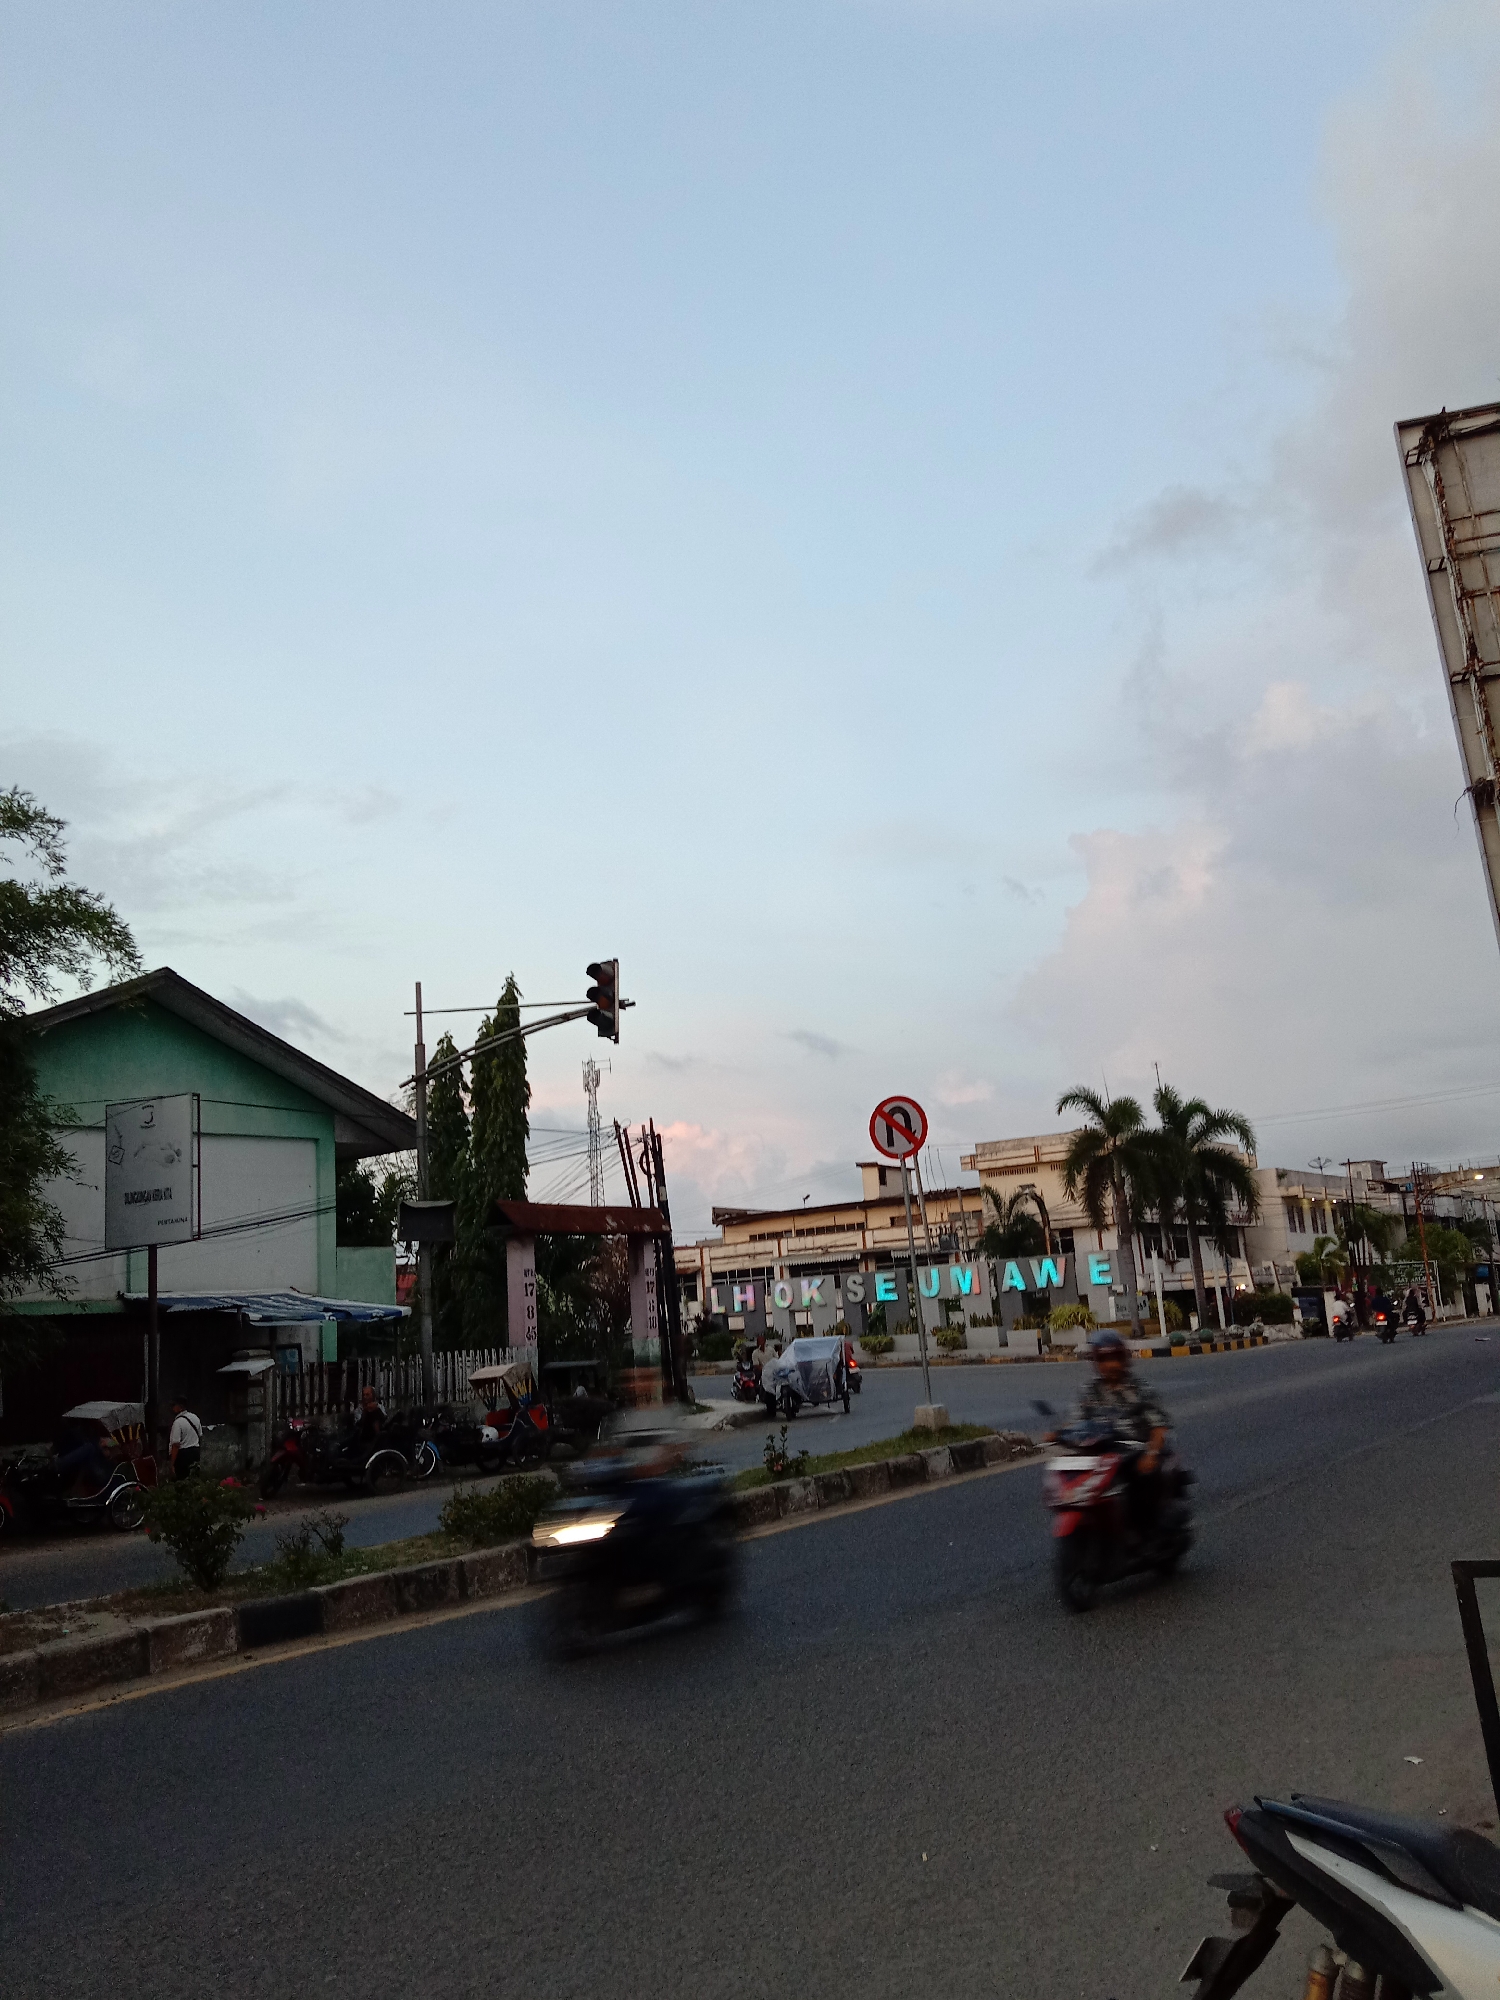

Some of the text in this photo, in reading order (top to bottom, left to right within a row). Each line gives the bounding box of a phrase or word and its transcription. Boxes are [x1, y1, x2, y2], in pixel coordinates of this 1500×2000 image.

[524, 1282, 535, 1297] 17
[646, 1281, 655, 1294] 17
[526, 1305, 535, 1320] 8
[525, 1325, 537, 1341] 45
